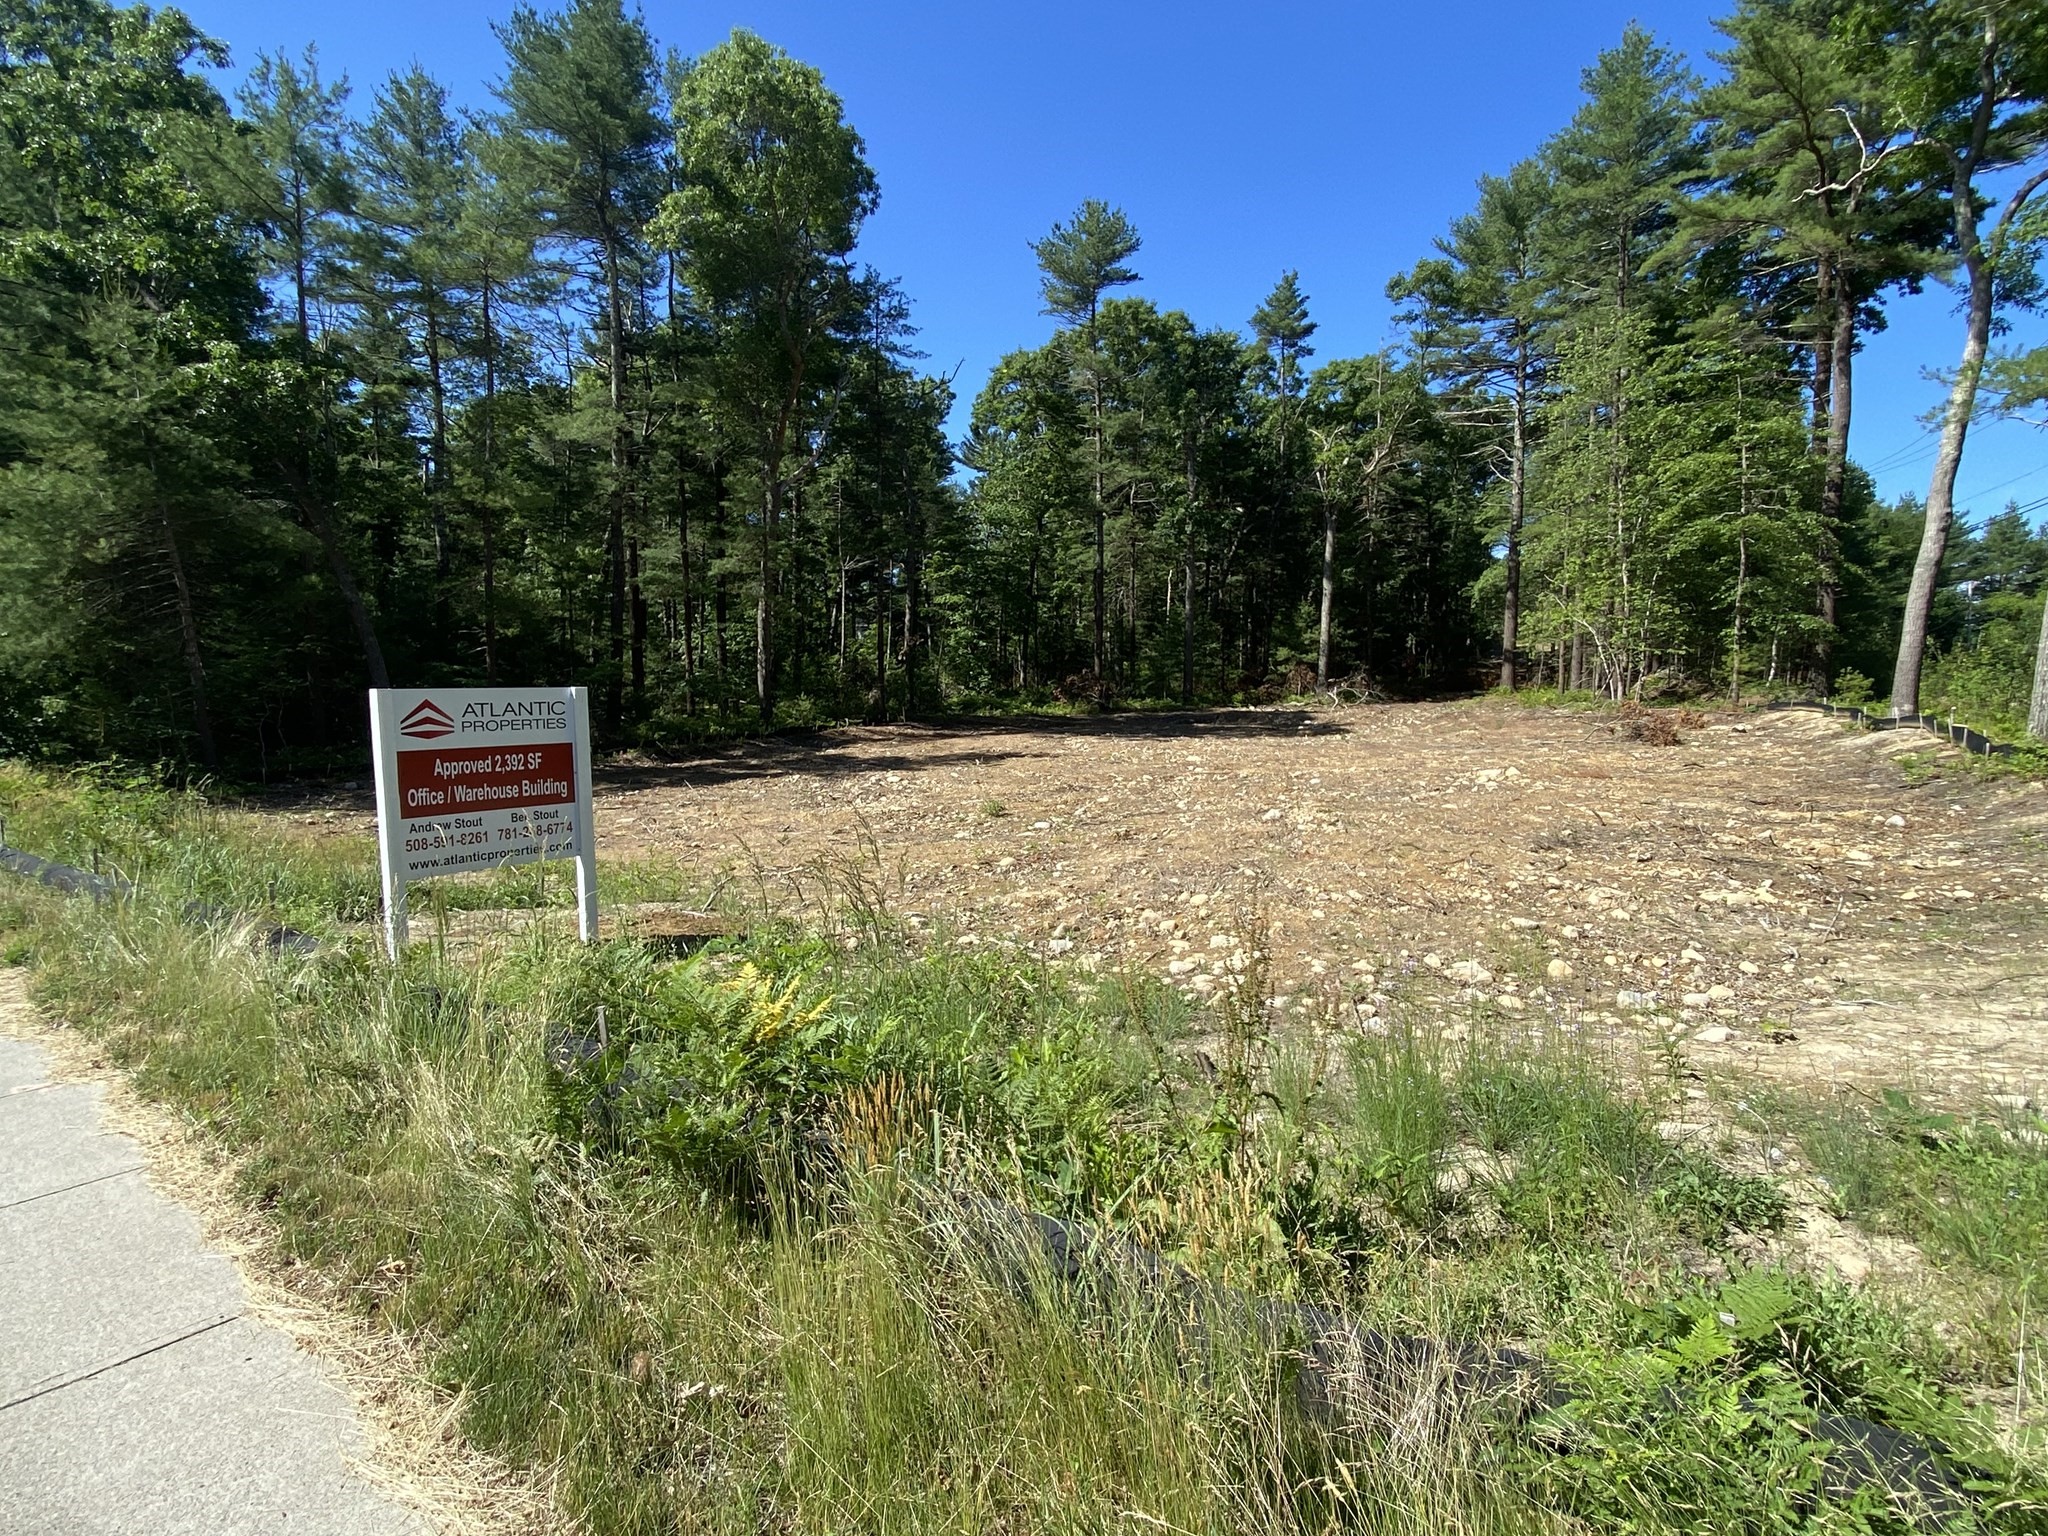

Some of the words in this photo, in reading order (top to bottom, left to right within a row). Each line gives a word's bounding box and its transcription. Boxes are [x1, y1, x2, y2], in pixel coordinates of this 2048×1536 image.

[461, 700, 567, 719] ATLANTIC
[461, 717, 567, 733] PROPERTIES
[433, 755, 493, 780] Approved
[494, 753, 525, 774] 2,392
[527, 752, 543, 770] SF
[407, 786, 446, 807] Office
[447, 788, 452, 803] /
[453, 782, 520, 801] Warehouse
[521, 778, 568, 797] Building
[454, 817, 483, 829] Stout
[533, 809, 560, 820] Stout
[497, 820, 574, 841] 781-28-6774
